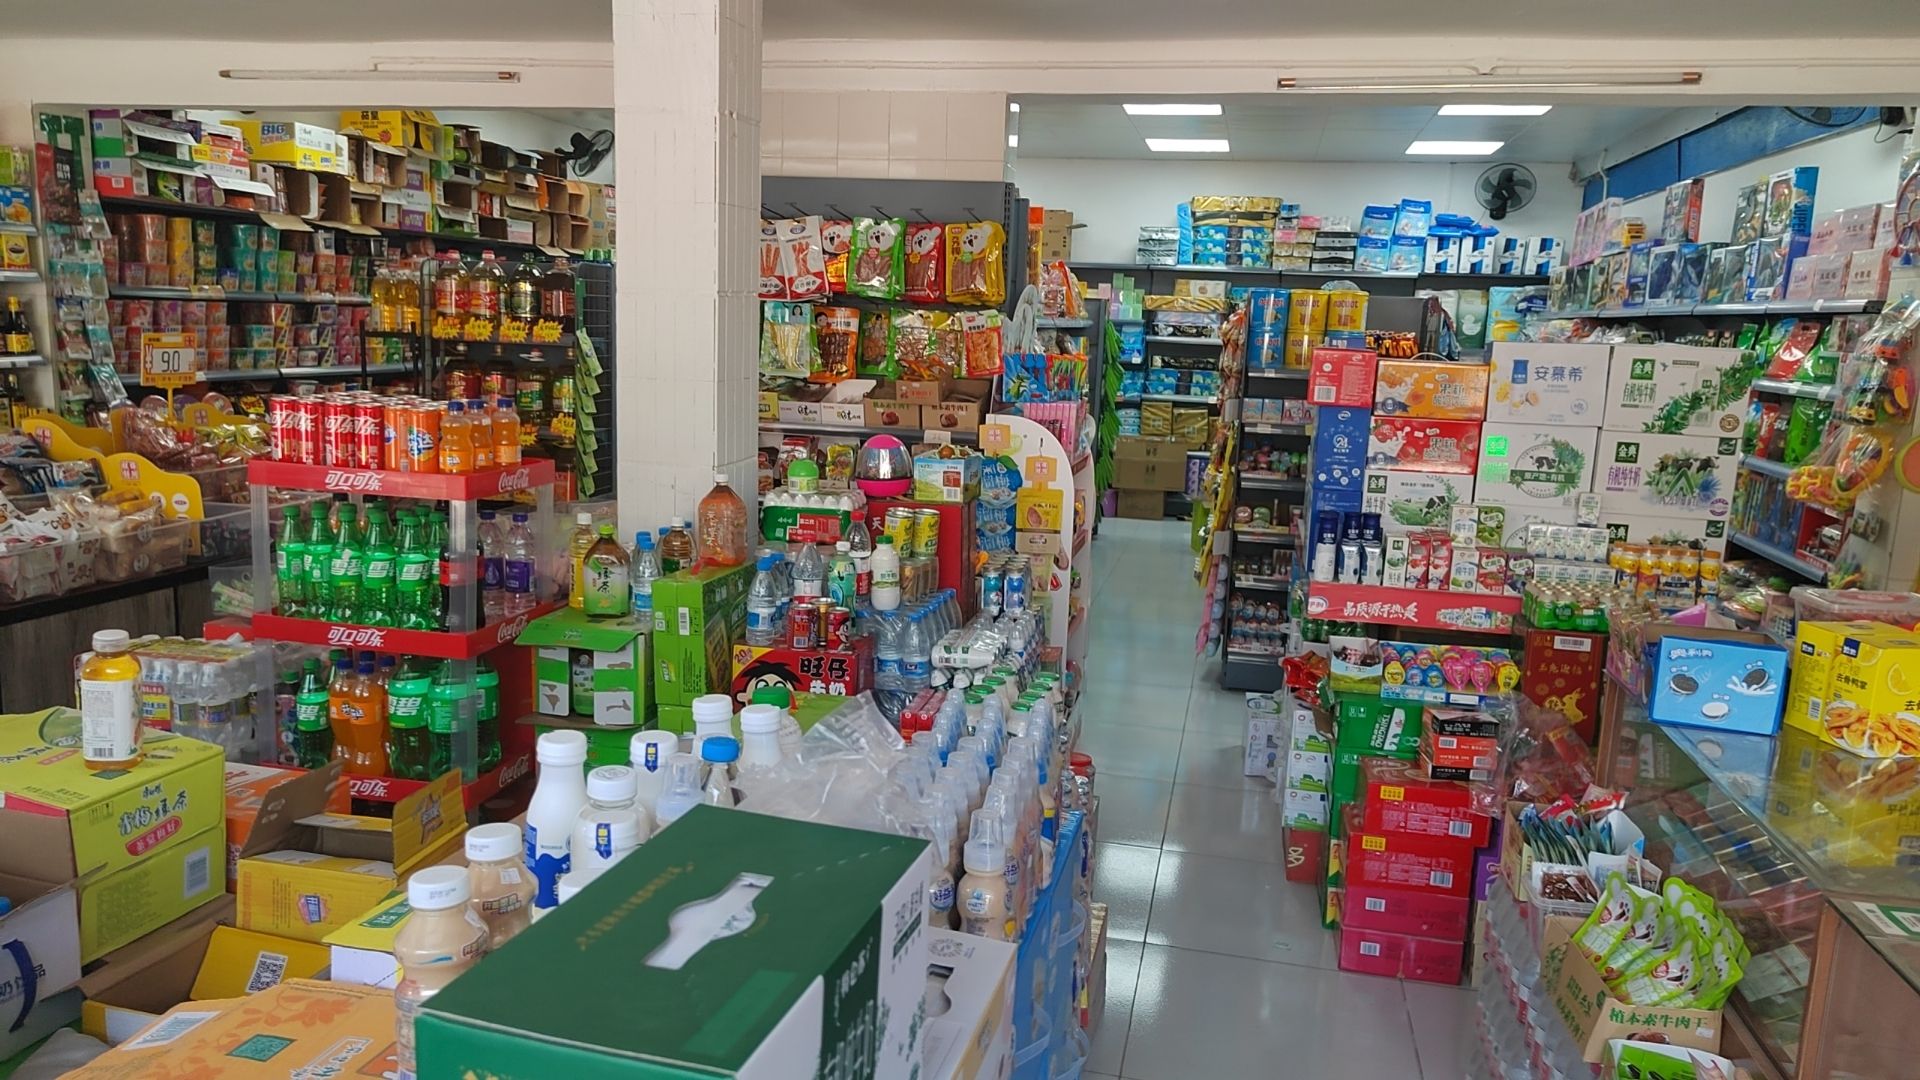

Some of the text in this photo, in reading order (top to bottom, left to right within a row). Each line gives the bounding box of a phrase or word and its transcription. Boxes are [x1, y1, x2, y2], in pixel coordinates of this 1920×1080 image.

[261, 124, 285, 136] BIG
[1534, 365, 1584, 383] 安慕希
[1633, 360, 1654, 375] 金典
[1618, 443, 1638, 458] 金典
[325, 470, 386, 491] 可口可乐
[1368, 476, 1386, 489] 金典
[872, 517, 884, 531] 天
[1608, 525, 1627, 539] 金典
[1344, 601, 1418, 623] 品质源于热爱
[327, 625, 387, 647] 可口可乐
[799, 656, 850, 680] 旺仔
[350, 779, 389, 798] 口可乐
[1608, 1006, 1709, 1030] 植本素牛肉干
